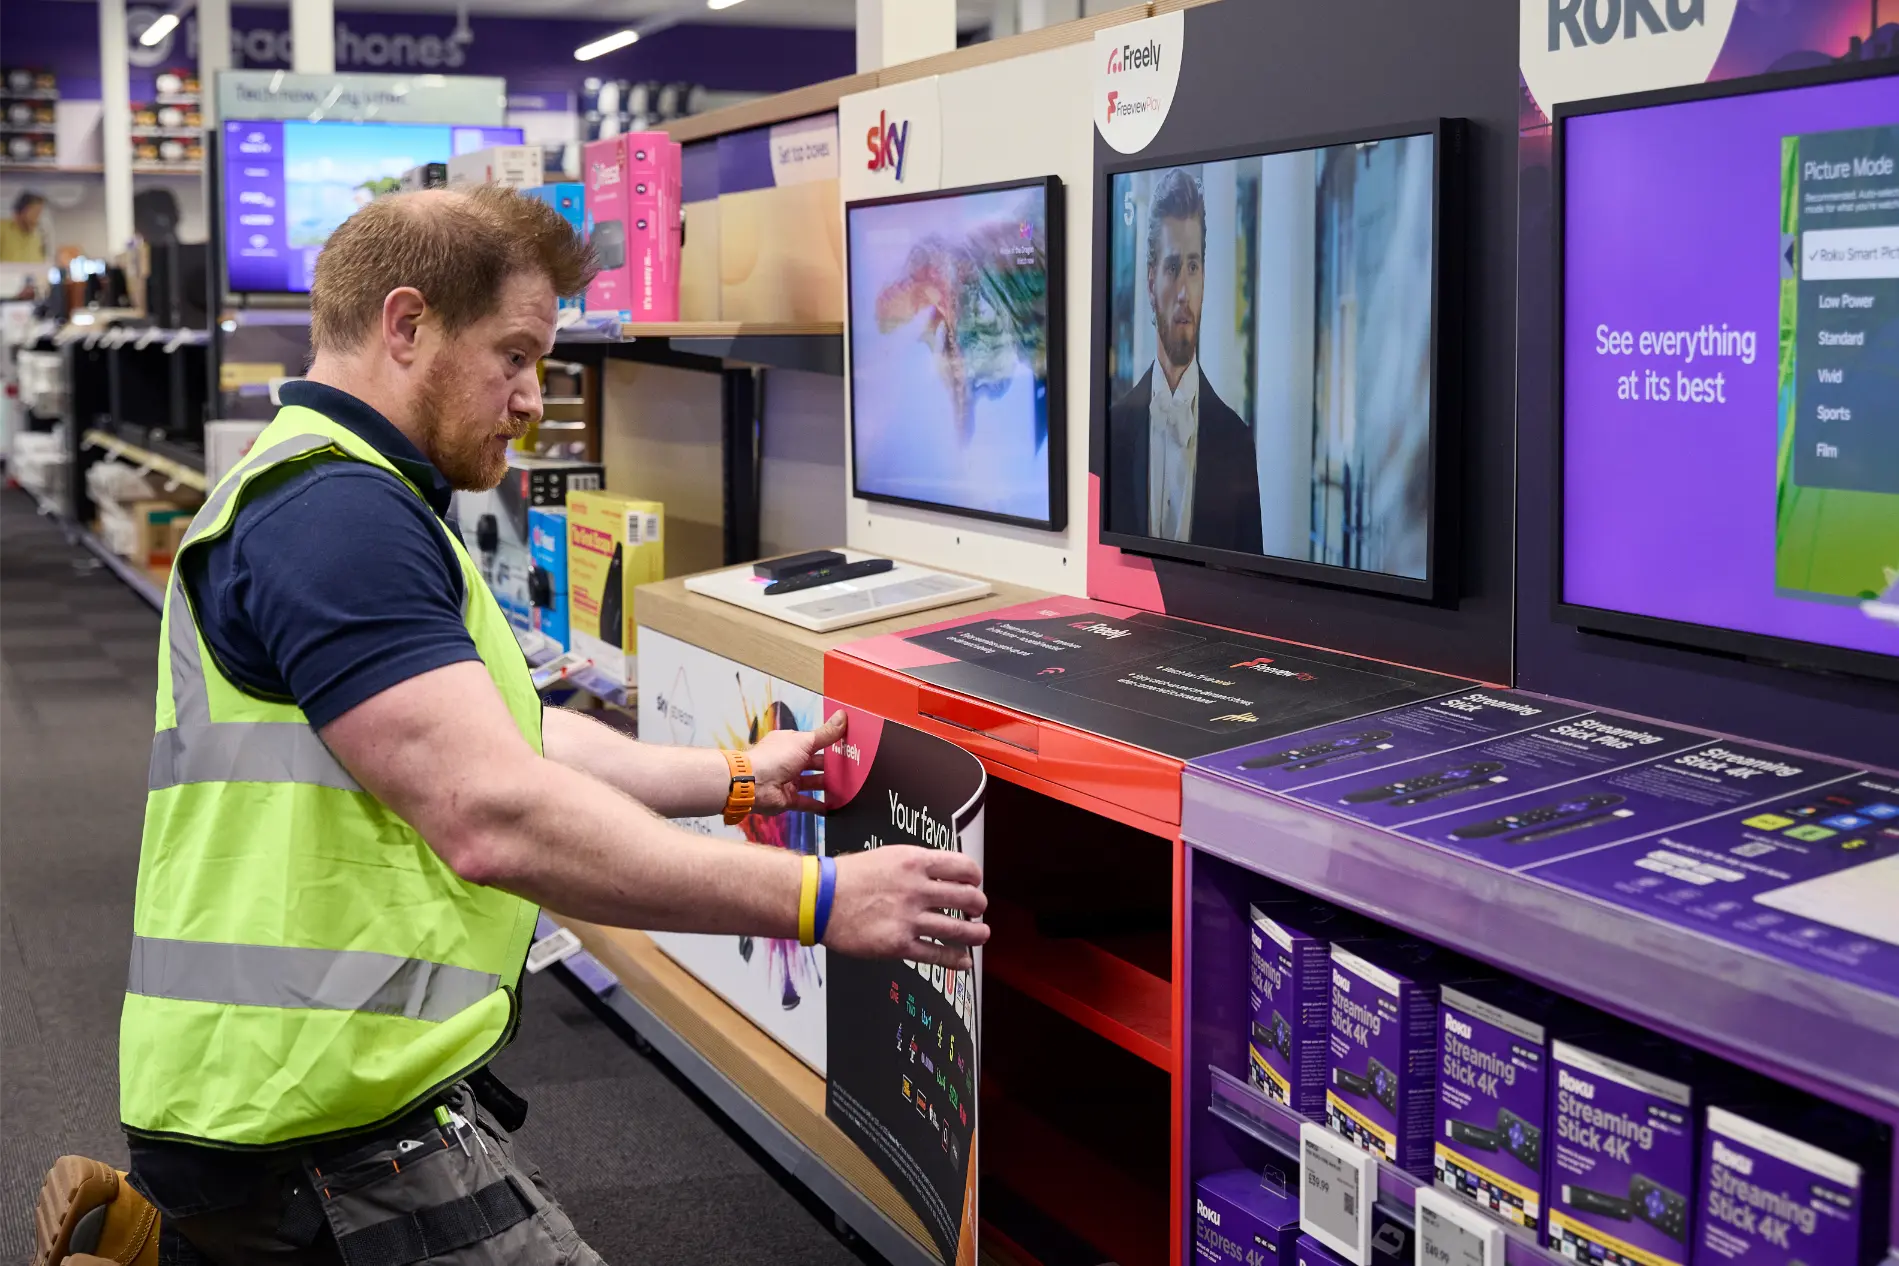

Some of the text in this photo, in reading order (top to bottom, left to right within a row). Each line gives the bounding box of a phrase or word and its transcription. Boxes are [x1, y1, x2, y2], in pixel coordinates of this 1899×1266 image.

[1123, 39, 1161, 72] Freely
[866, 109, 909, 181] sky
[1804, 156, 1894, 181] Picture Mode
[1019, 220, 1034, 240] sky
[1820, 249, 1845, 261] Roku
[1848, 247, 1878, 261] Smart
[1818, 293, 1875, 309] Low Power
[1595, 323, 1757, 365] See everything
[1818, 331, 1865, 346] Standard
[1617, 368, 1727, 404] at its best
[1817, 369, 1843, 384] Vivid
[1816, 405, 1851, 423] Sports
[1816, 443, 1838, 459] Film
[1081, 622, 1132, 641] Freely
[1440, 699, 1483, 713] Stick
[1463, 693, 1542, 716] Streaming
[1550, 725, 1598, 741] Stick
[1591, 735, 1634, 749] Plus
[1573, 719, 1663, 745] Streaming
[841, 739, 861, 766] Freely
[1699, 748, 1804, 777] Streaming
[1674, 755, 1729, 772] Stick
[1724, 767, 1764, 780] 4K
[889, 789, 920, 836] Your
[1332, 985, 1380, 1036] Streaming
[1331, 1006, 1368, 1048] Stick 4K
[1444, 1031, 1516, 1086] Streaming
[1443, 1054, 1475, 1089] Stick
[1477, 1072, 1499, 1100] 4K
[1557, 1090, 1653, 1151] Streaming
[1556, 1114, 1601, 1153] Stick
[1602, 1135, 1631, 1165] 4K
[1710, 1163, 1817, 1236] Streaming
[1708, 1190, 1756, 1234] Stick
[1758, 1216, 1790, 1250] 4K
[1196, 1217, 1243, 1262] Express
